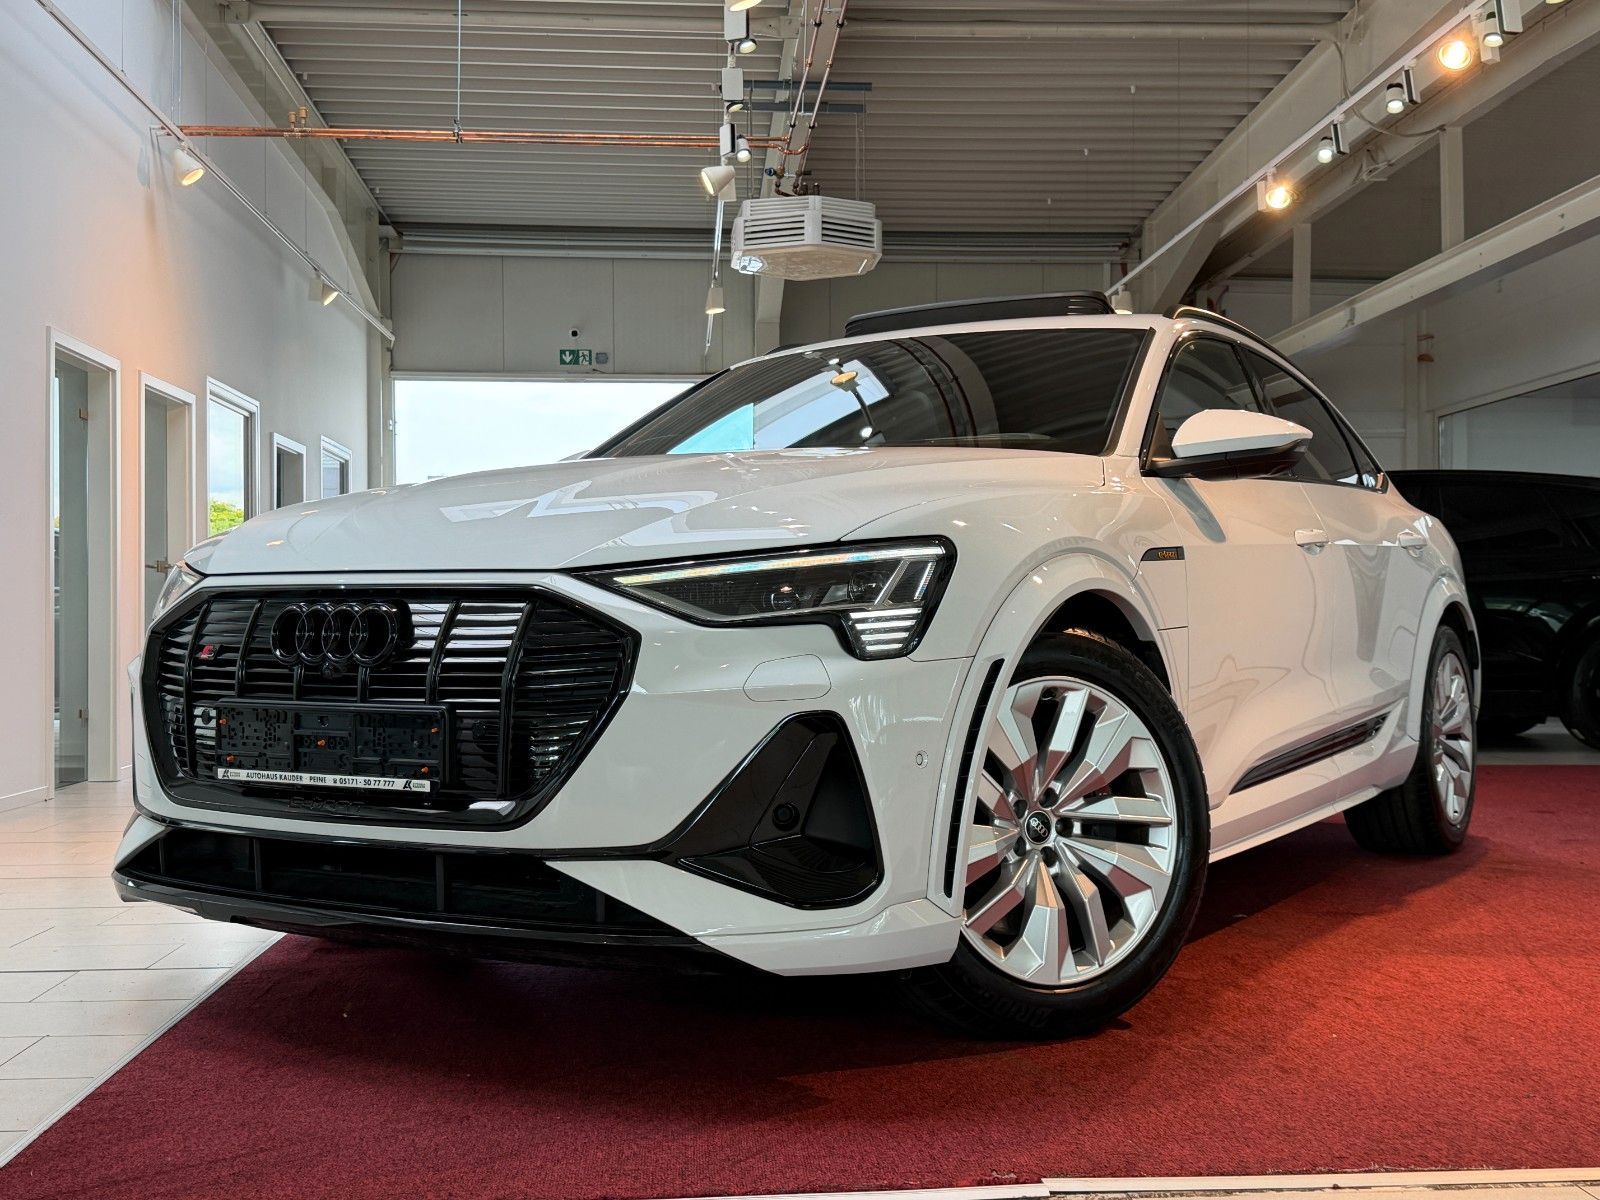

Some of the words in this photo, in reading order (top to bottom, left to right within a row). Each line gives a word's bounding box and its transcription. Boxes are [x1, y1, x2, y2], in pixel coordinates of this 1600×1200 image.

[245, 772, 278, 781] AUTOHAUS
[279, 774, 303, 782] KAUDER
[309, 775, 327, 784] PEINE
[339, 777, 358, 785] 05171
